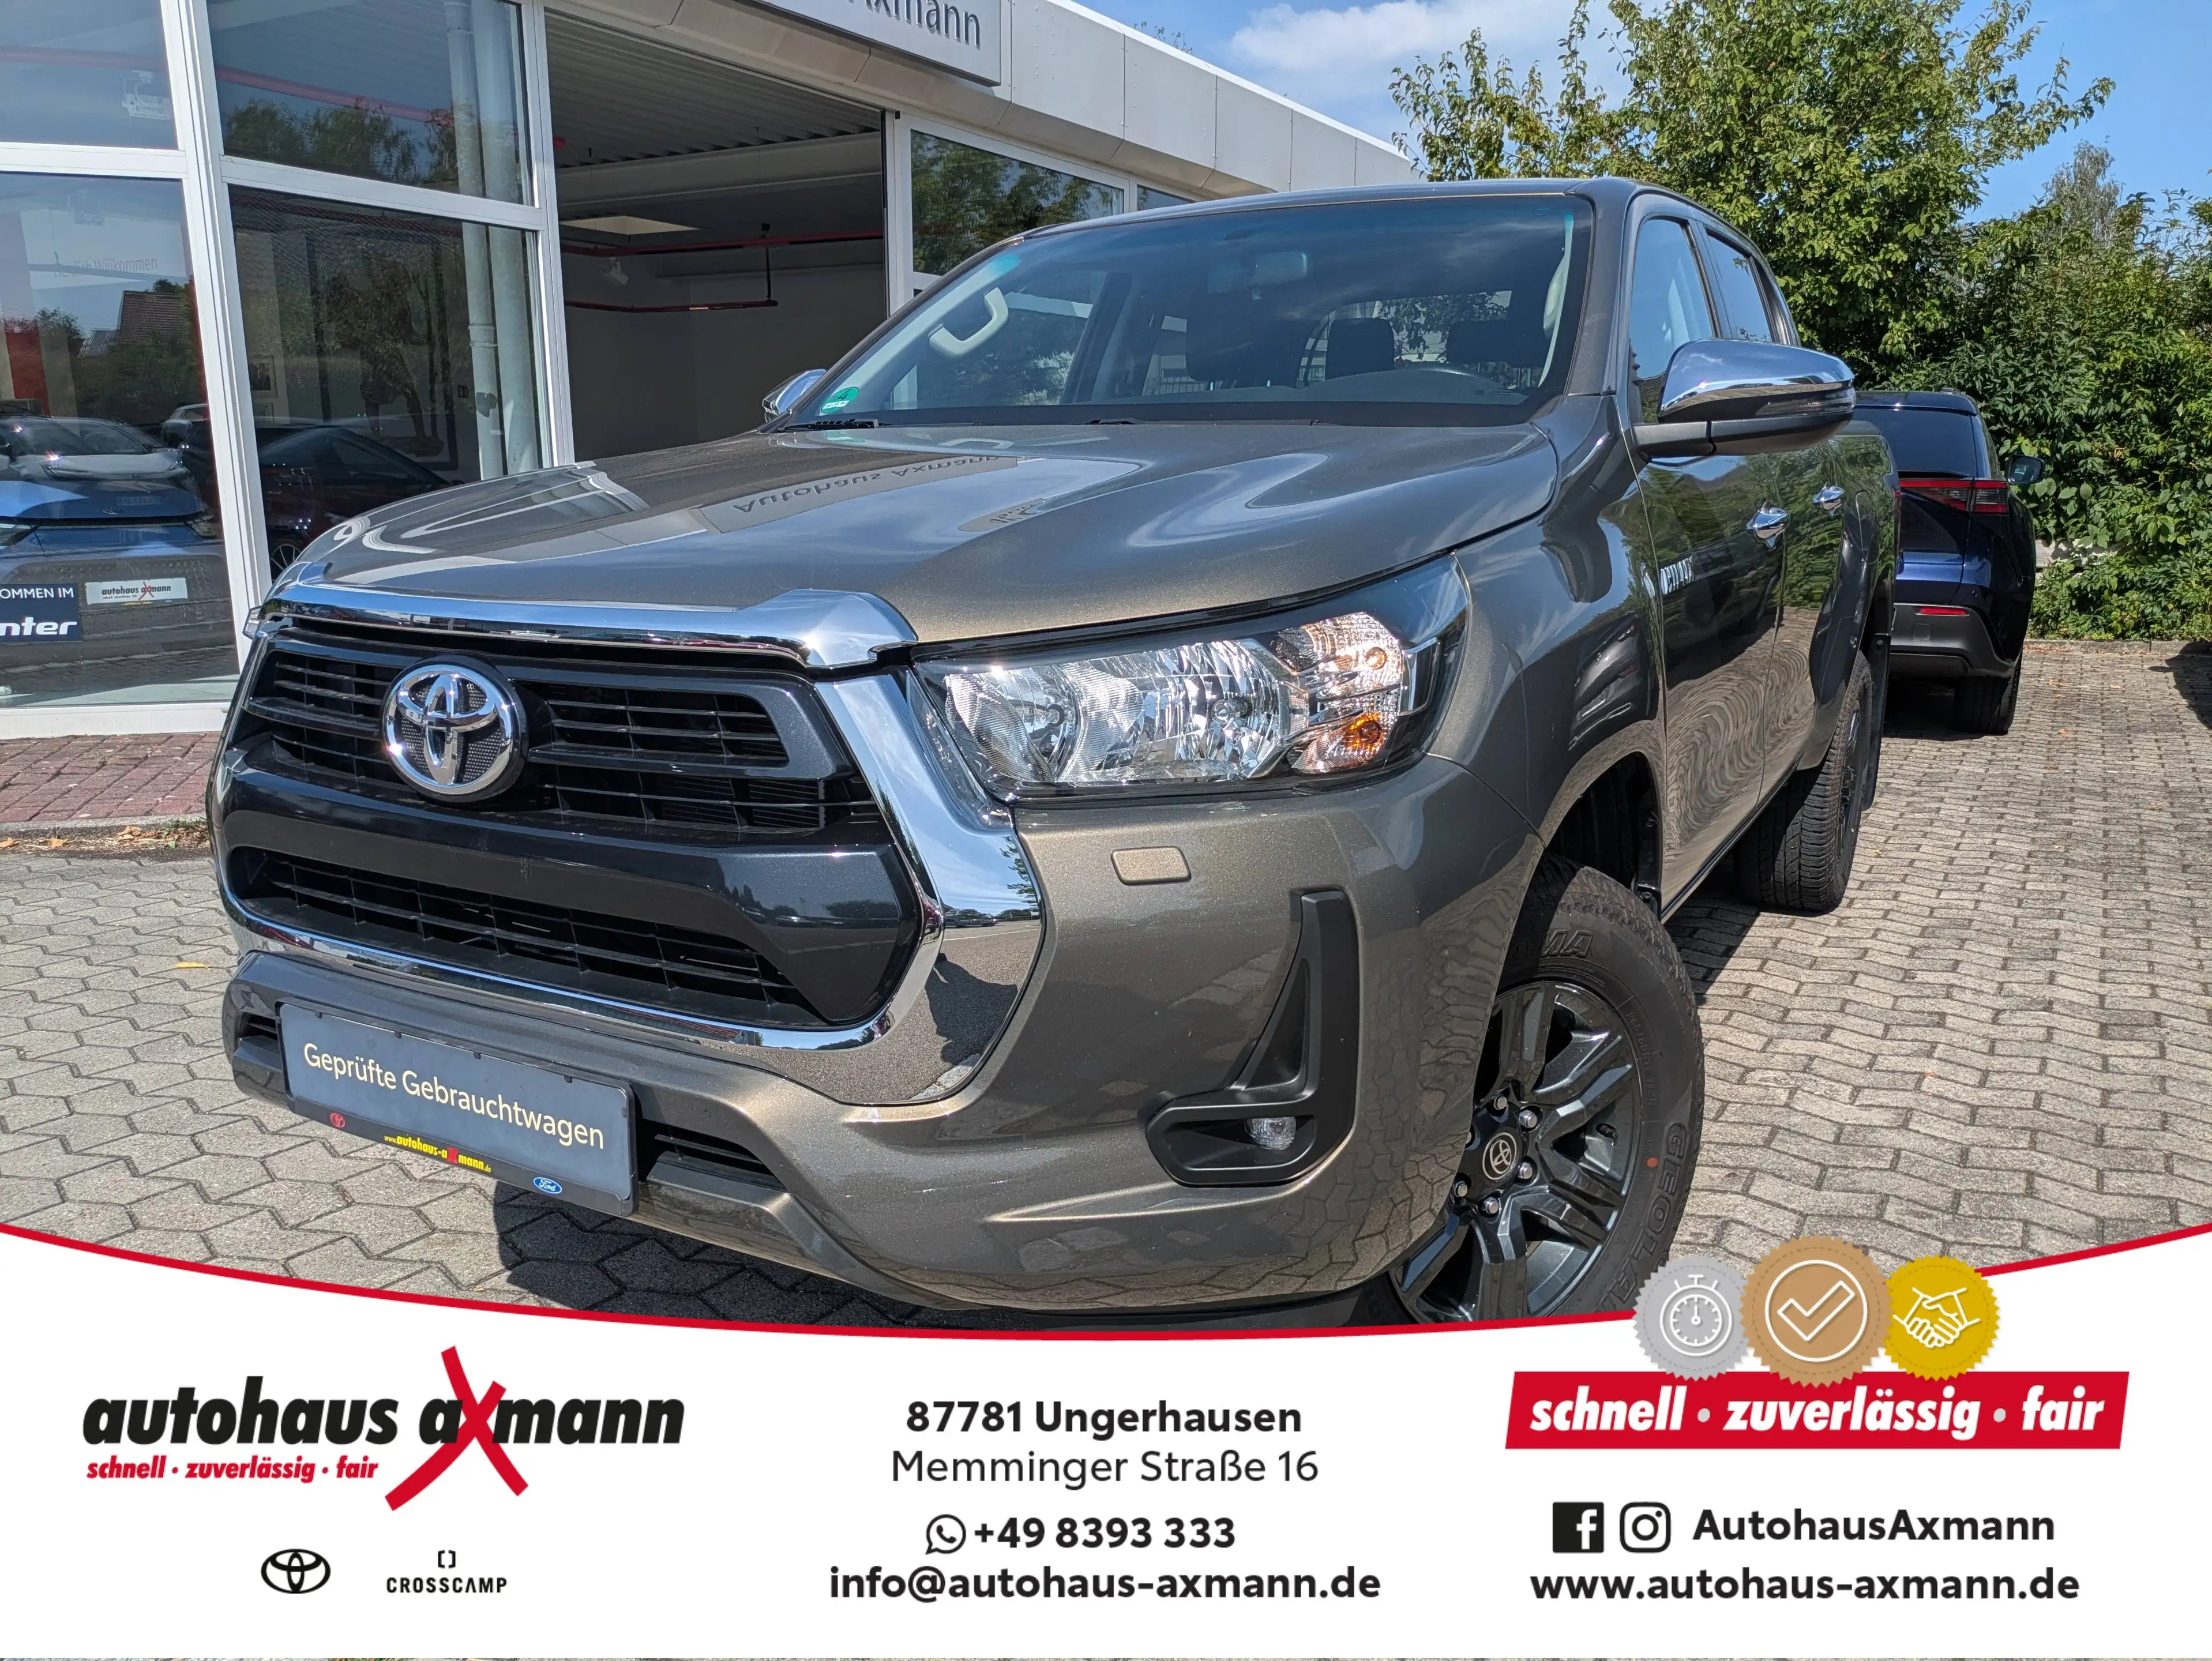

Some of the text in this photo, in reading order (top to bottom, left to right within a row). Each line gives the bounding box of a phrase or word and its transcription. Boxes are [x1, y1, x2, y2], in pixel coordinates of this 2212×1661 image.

[93, 256, 158, 273] Willkommen
[0, 587, 74, 599] OMMEN IM
[102, 585, 138, 595] autohaus
[304, 1042, 604, 1149] Geprüfte Gebrauchtwagen
